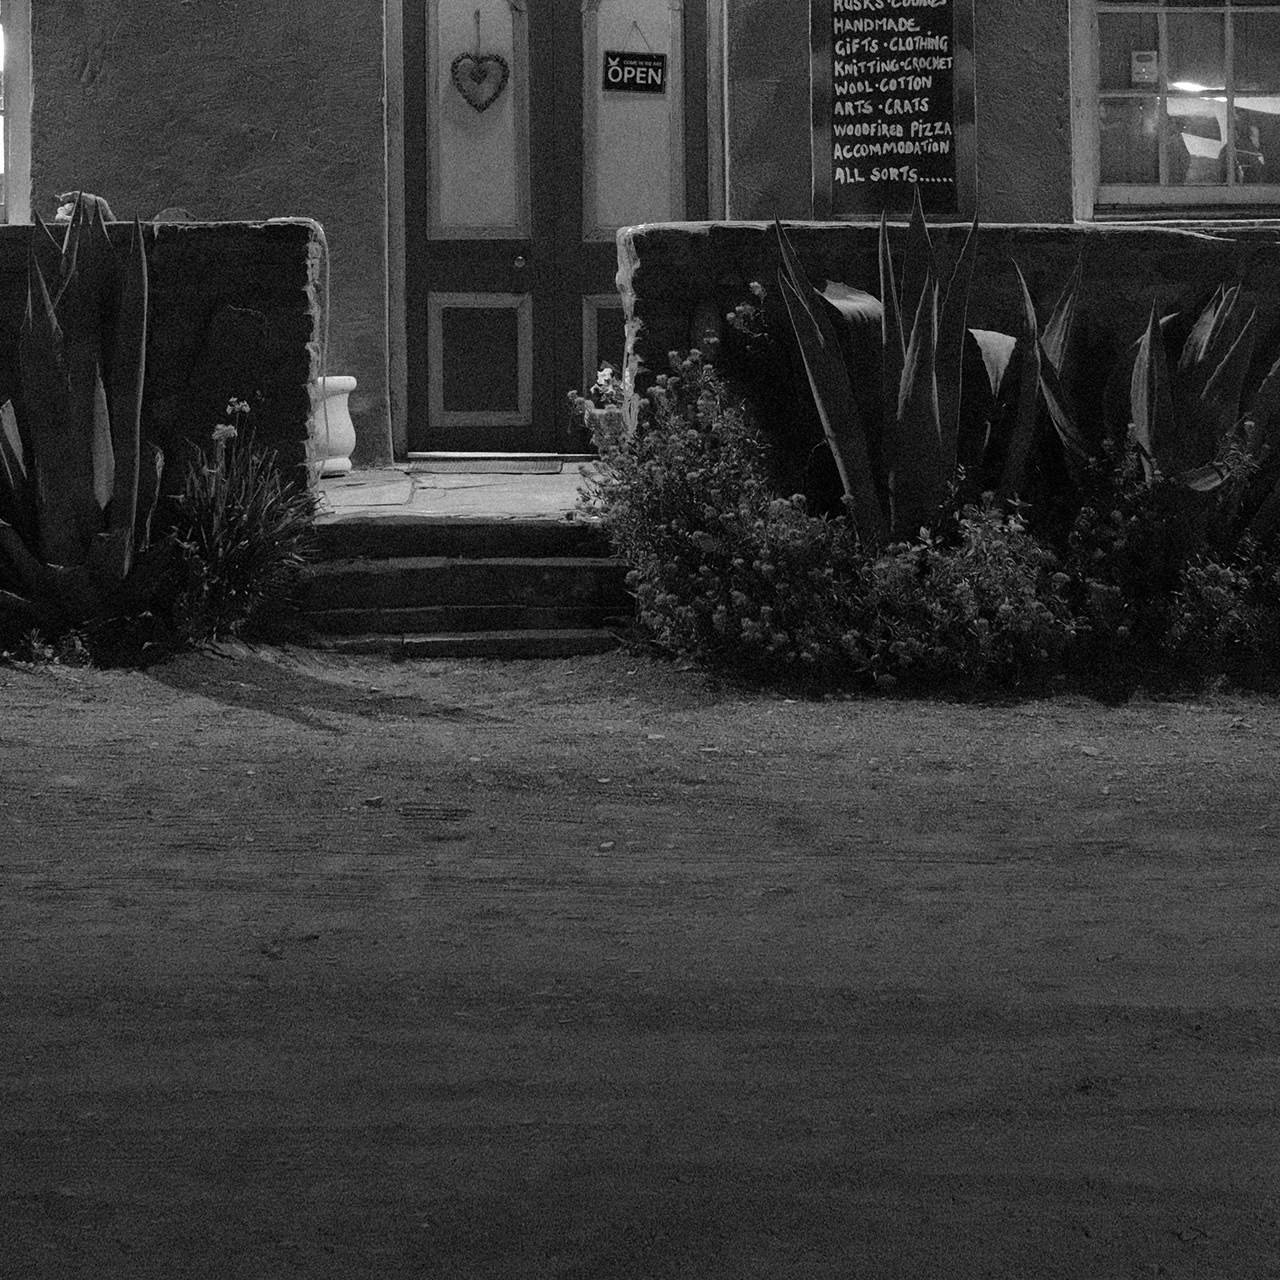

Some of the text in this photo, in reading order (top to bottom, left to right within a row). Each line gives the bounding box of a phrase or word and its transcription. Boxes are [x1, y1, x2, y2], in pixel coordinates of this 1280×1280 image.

[833, 17, 921, 34] HANDMADE
[903, 55, 953, 72] CROCHET
[608, 66, 662, 84] OPEN
[834, 75, 933, 96] WOOL COTTON
[834, 97, 930, 116] ARTS CRATS
[835, 166, 866, 184] ALL
